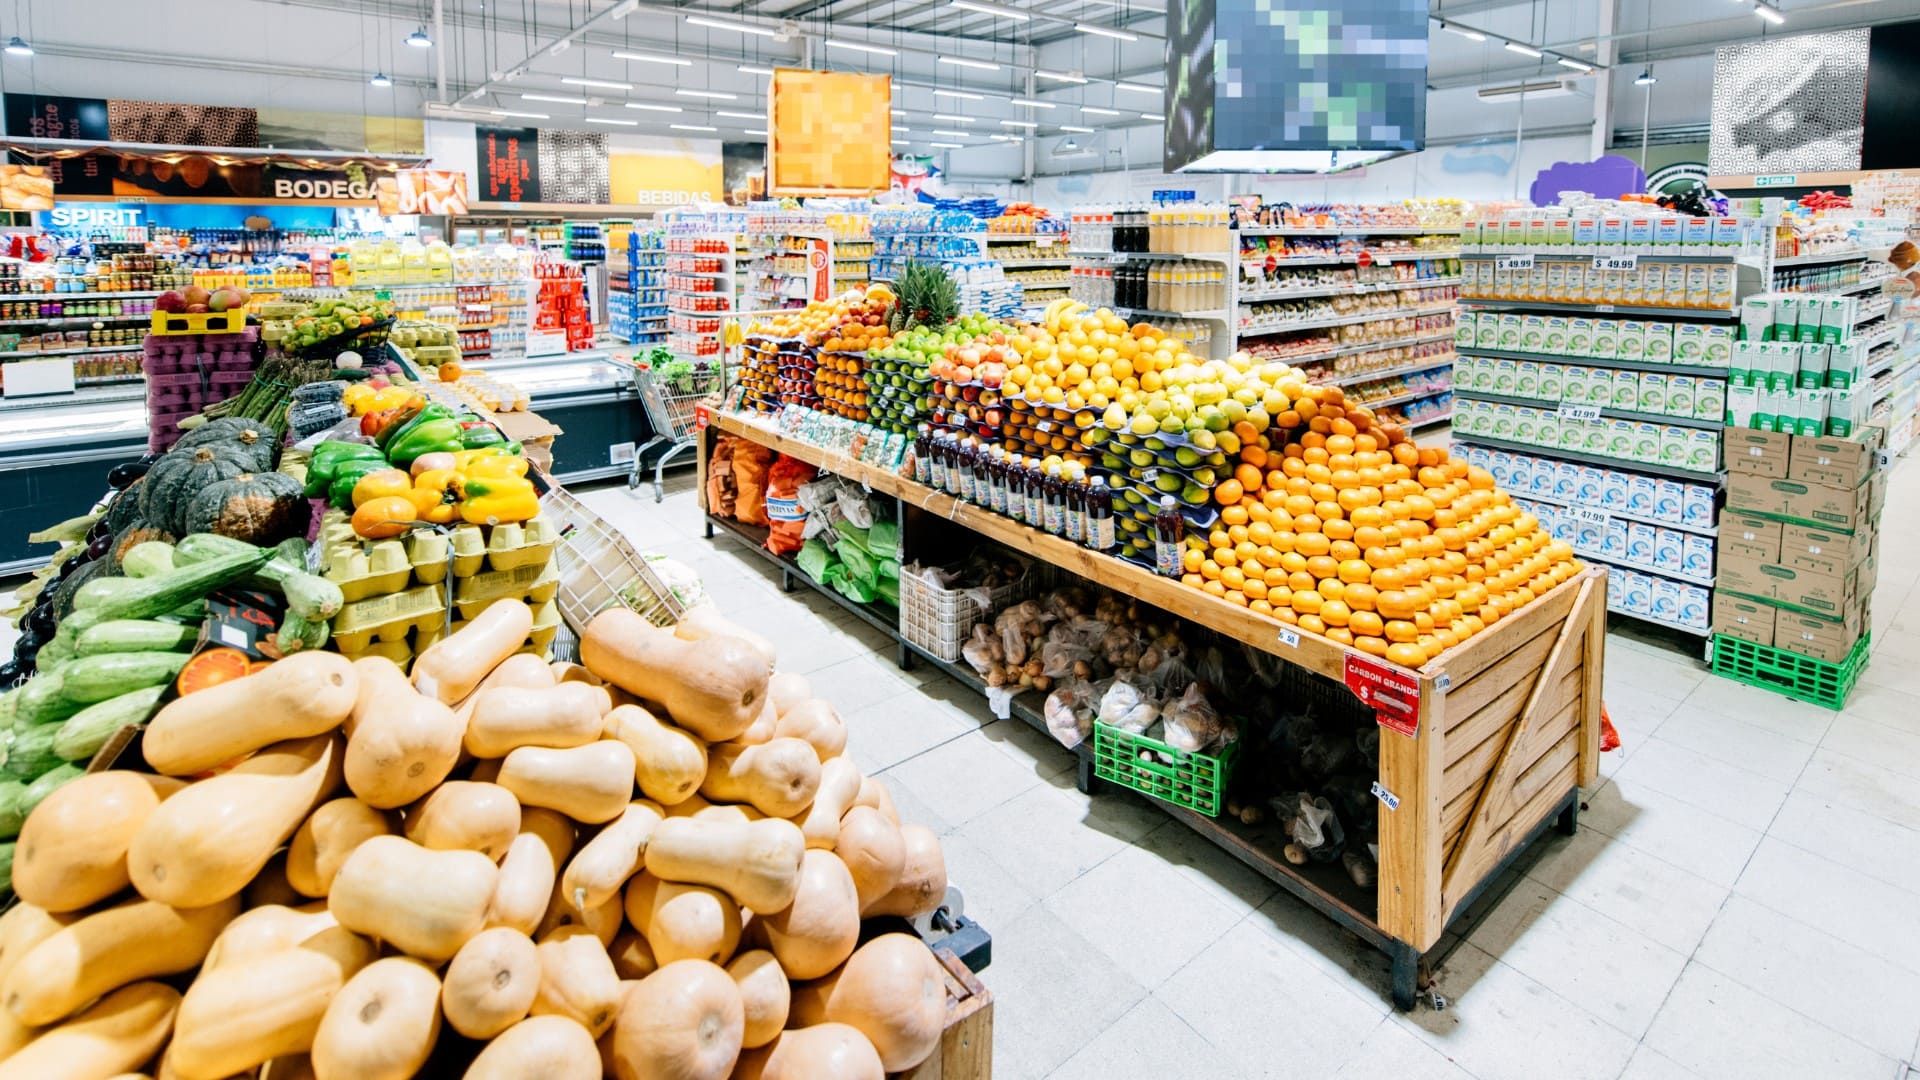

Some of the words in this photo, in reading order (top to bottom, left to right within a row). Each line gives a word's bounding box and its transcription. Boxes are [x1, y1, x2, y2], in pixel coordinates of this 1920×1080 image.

[638, 189, 712, 205] BEBIDAS
[51, 207, 142, 227] SPIRIT
[1508, 259, 1531, 268] 49.99
[1607, 260, 1633, 269] 49.99
[1580, 510, 1605, 523] 47.99
[1348, 664, 1382, 684] CARBON
[1383, 678, 1419, 698] GRANDE
[1360, 685, 1369, 699] $
